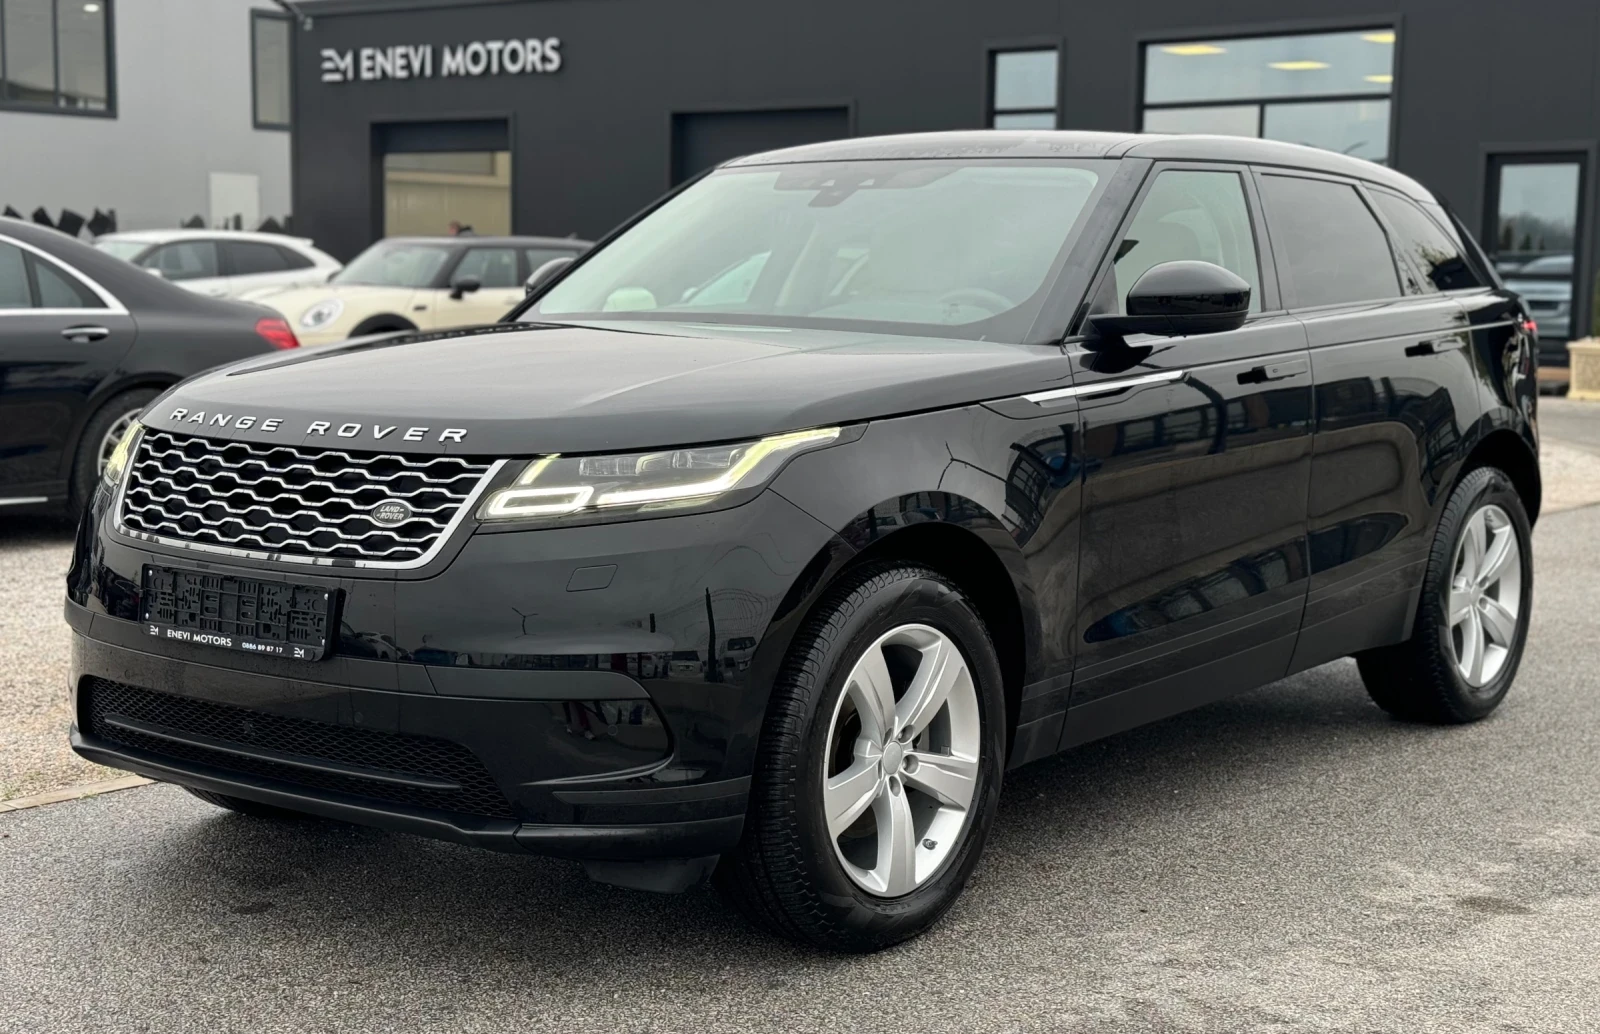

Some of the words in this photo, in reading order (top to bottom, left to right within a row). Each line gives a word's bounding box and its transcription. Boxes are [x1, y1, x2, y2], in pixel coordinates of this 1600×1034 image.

[360, 44, 432, 80] ENEVI
[441, 37, 561, 77] MOTORS
[170, 408, 283, 432] RANGE
[307, 421, 468, 442] ROVER
[167, 629, 190, 640] ENEVI
[192, 634, 232, 647] MOTORS
